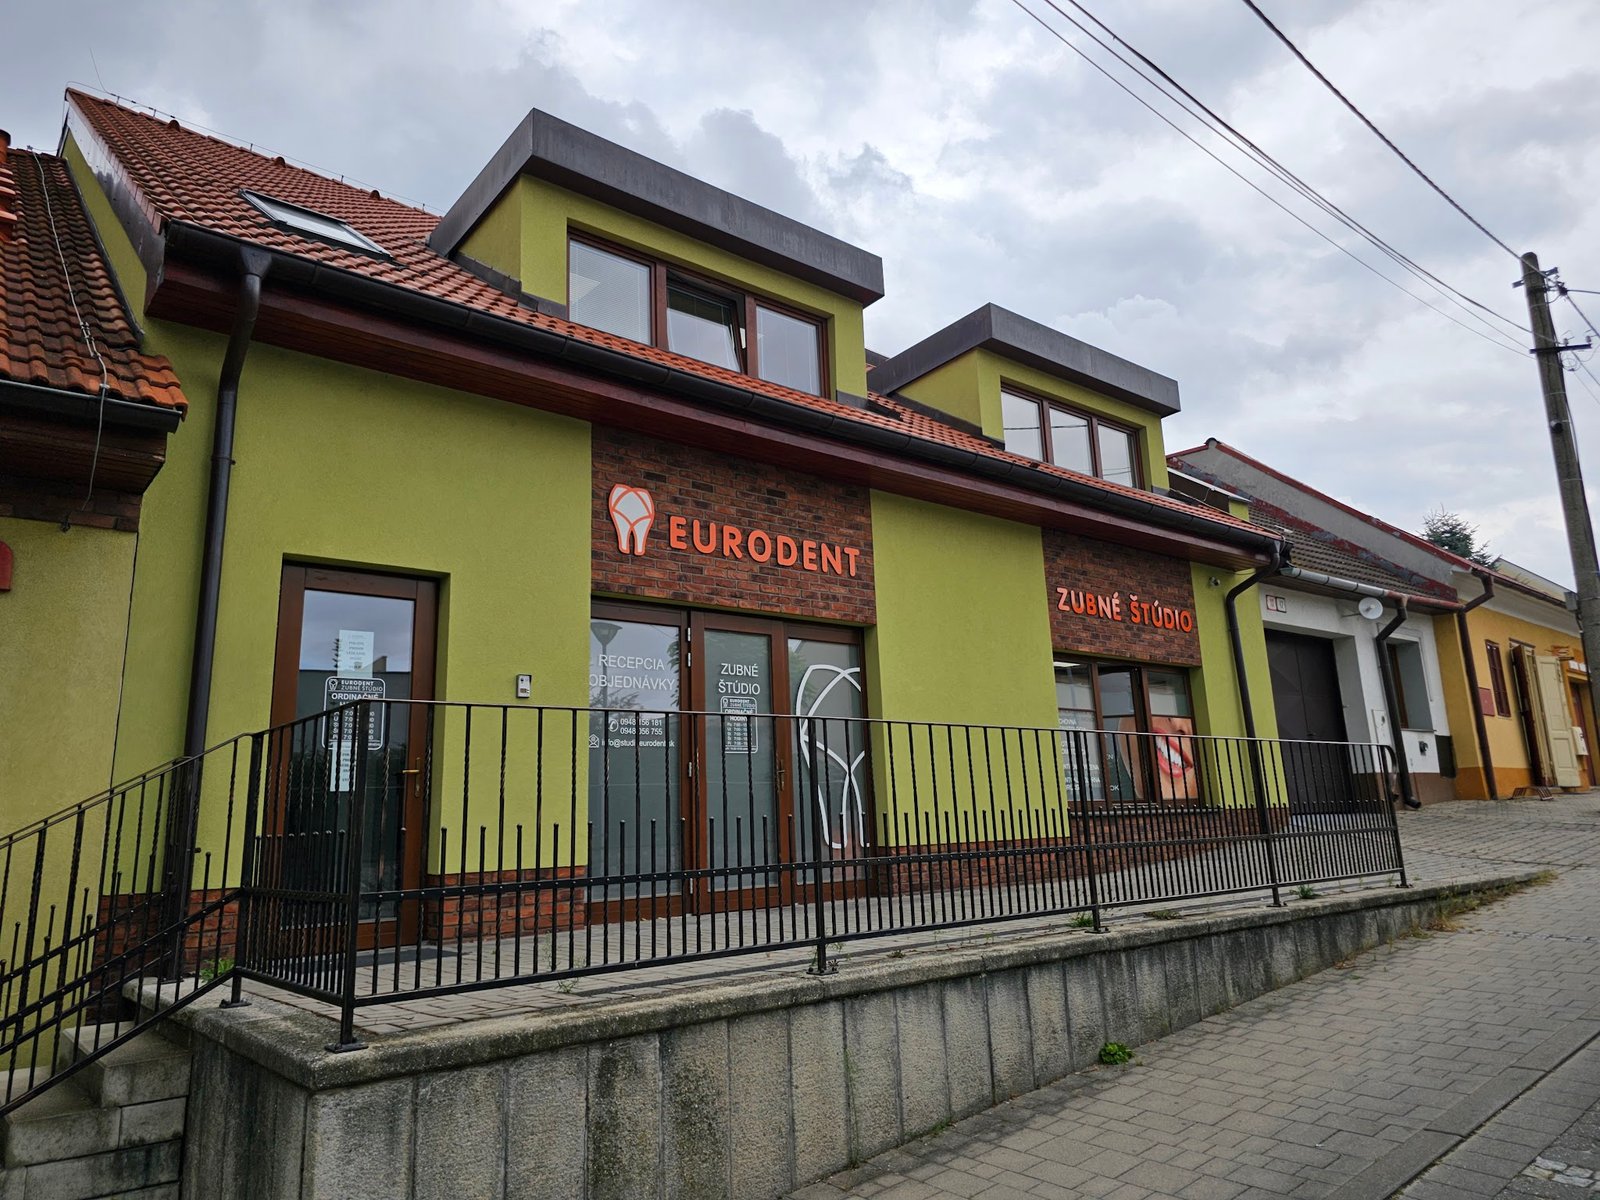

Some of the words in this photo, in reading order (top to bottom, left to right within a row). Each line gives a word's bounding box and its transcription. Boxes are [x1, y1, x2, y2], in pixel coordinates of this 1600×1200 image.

[669, 516, 860, 577] EURODENT
[1056, 587, 1122, 621] ZUBNÉ
[1129, 593, 1193, 633] ŠTÚDIO
[598, 654, 665, 671] RECEPCIA
[720, 663, 759, 677] ZUBNÉ
[589, 674, 675, 691] OBJEDNÁVKY
[718, 680, 761, 695] ŠTÚDIO
[619, 727, 636, 735] 0948
